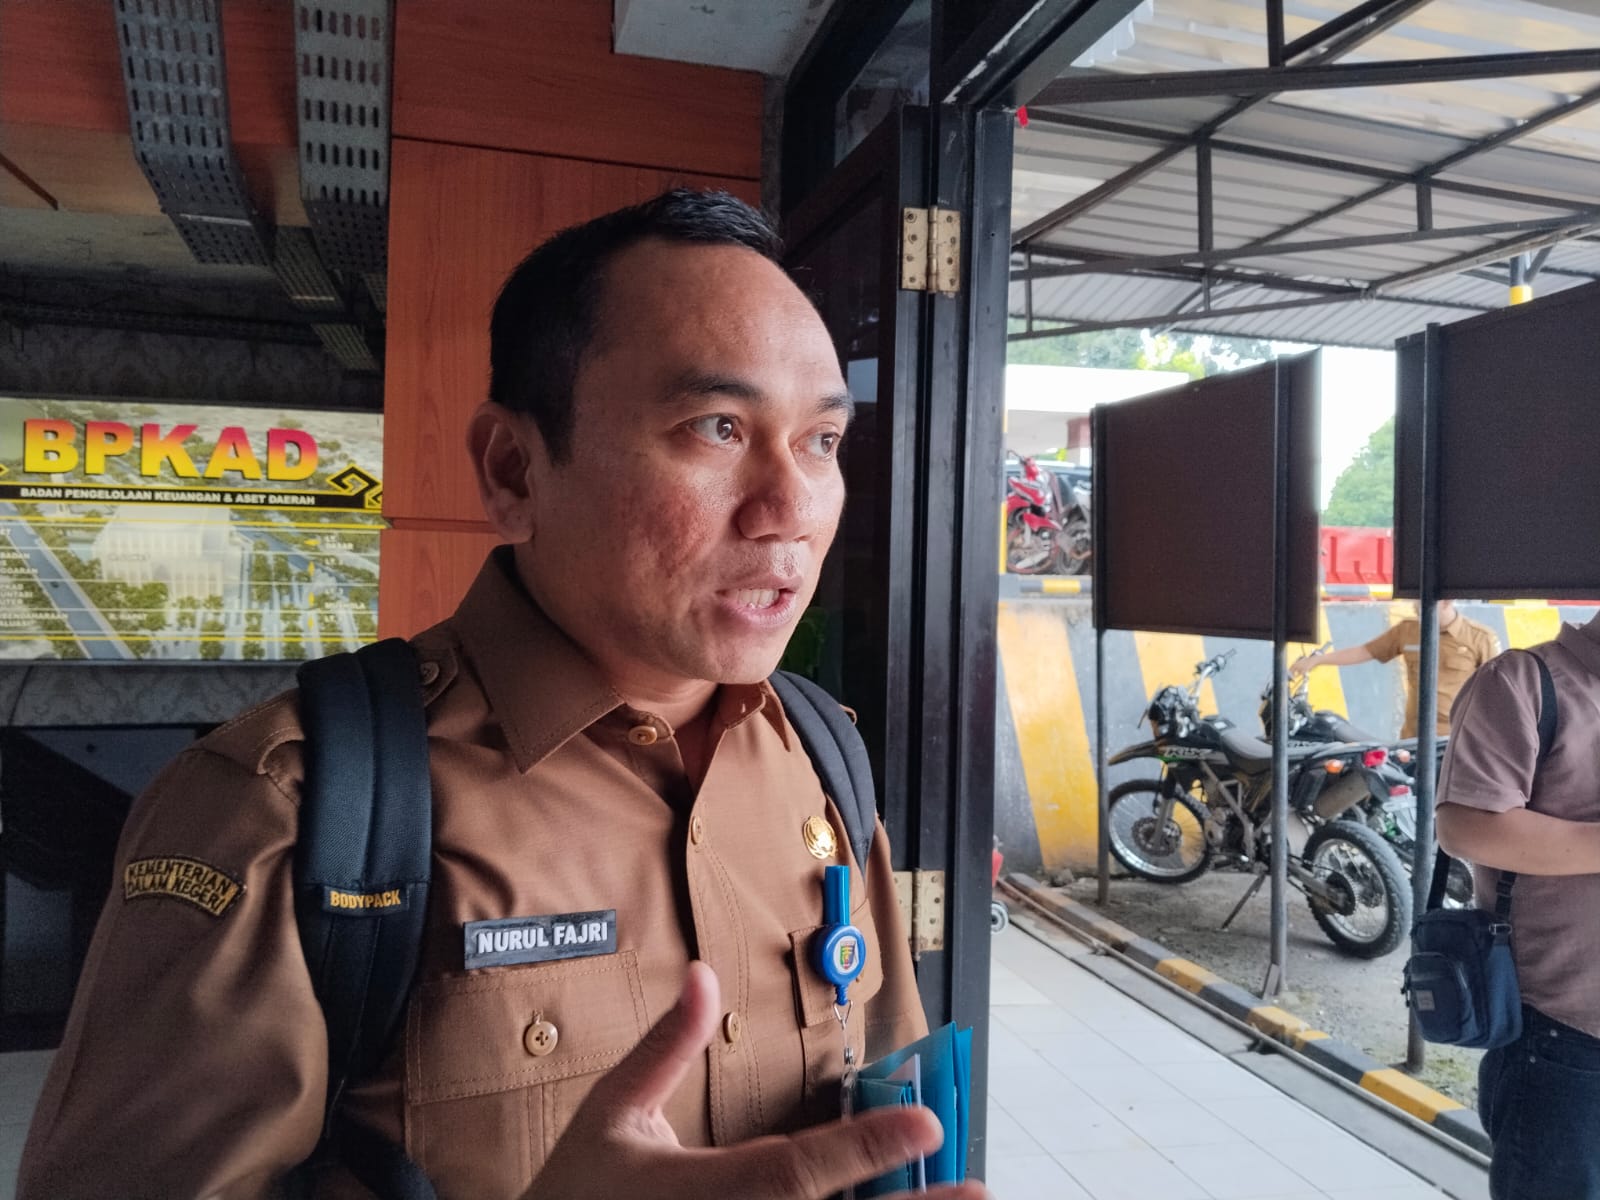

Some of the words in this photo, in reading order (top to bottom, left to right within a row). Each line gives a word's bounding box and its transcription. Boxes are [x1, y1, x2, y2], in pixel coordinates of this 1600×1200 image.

[24, 419, 319, 481] BPKAD
[20, 487, 62, 498] BADAN
[64, 489, 152, 500] PENGELOLAAN
[154, 491, 221, 503] KEUANGAN
[223, 493, 233, 503] &
[235, 494, 267, 504] ASET
[268, 495, 316, 505] DAERAH
[127, 860, 232, 896] KEMENTERIAN
[127, 875, 170, 896] DALAM
[171, 878, 227, 912] NEGERI
[329, 888, 402, 909] BODYPACK
[477, 927, 549, 954] NURUL
[553, 922, 608, 946] FAJRI
